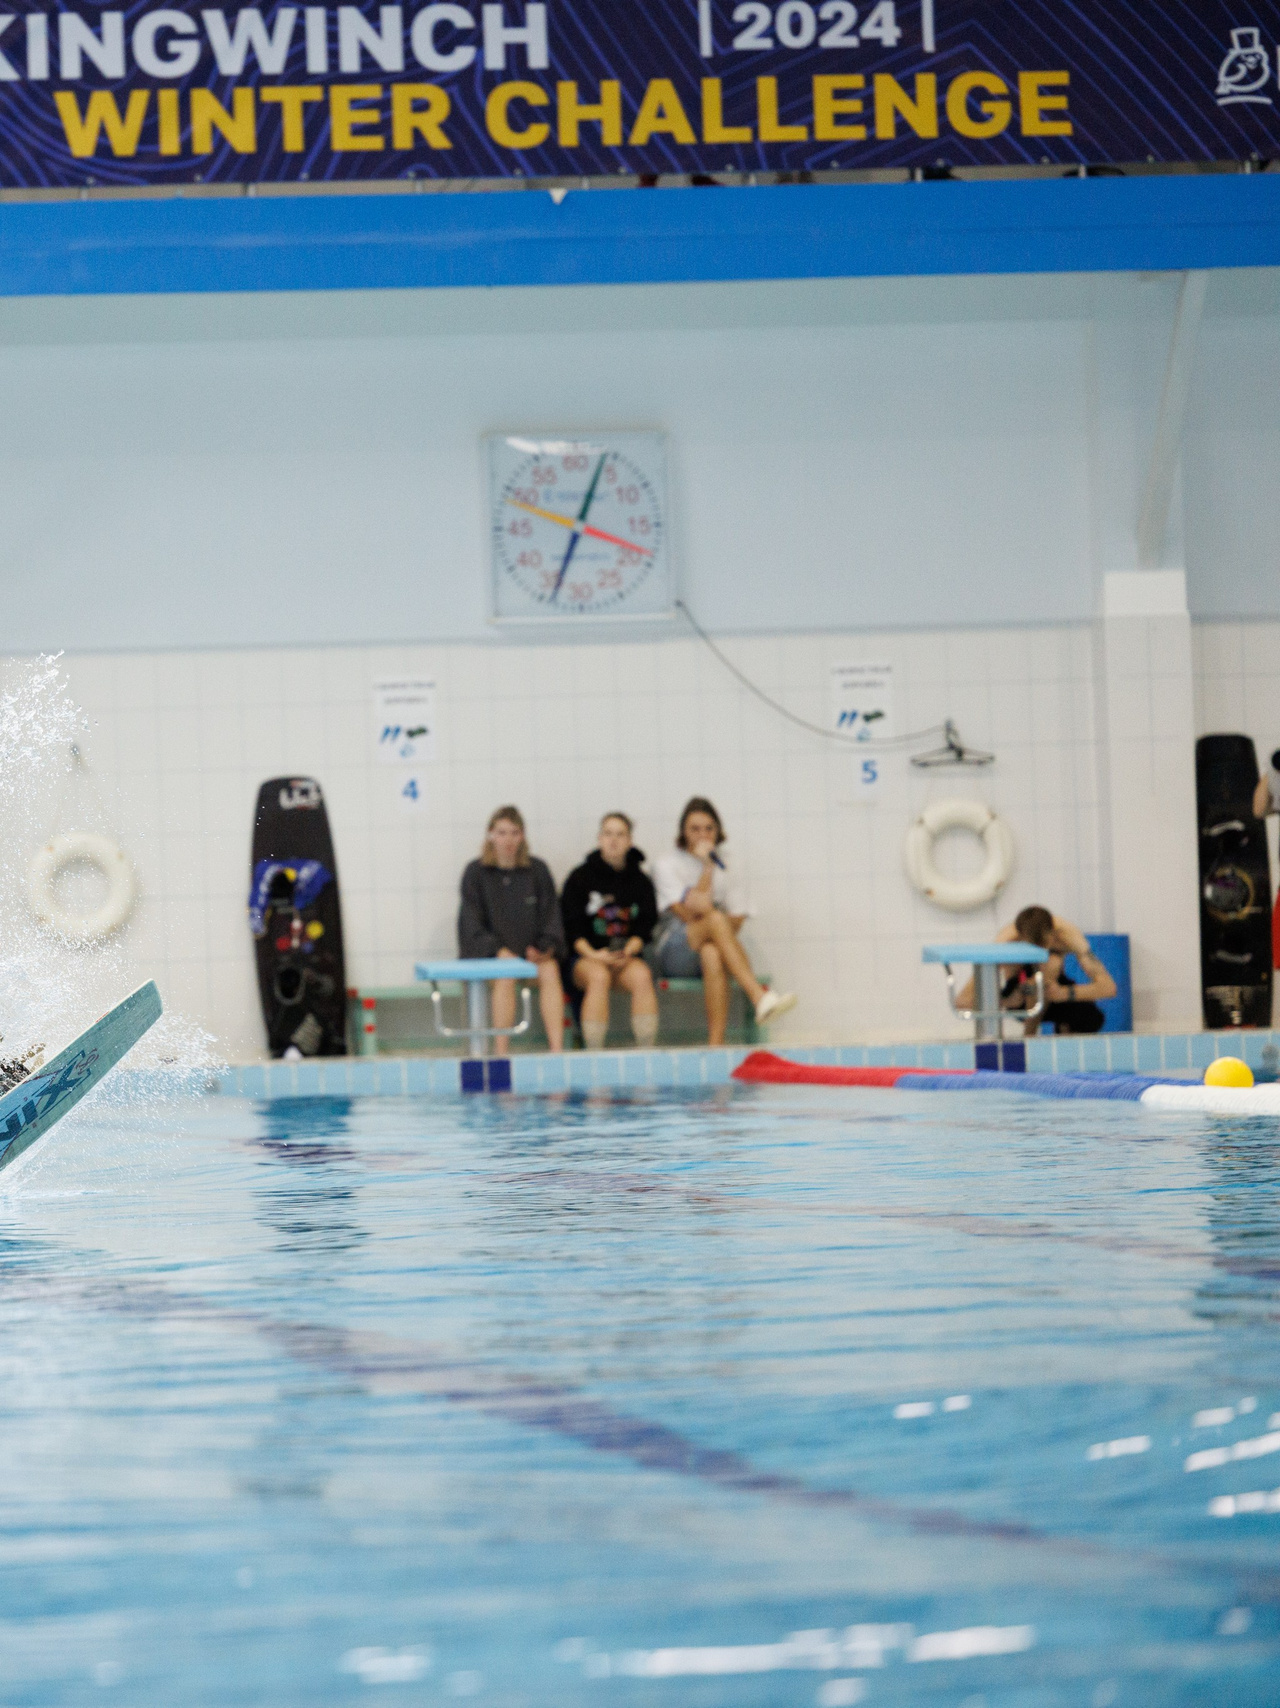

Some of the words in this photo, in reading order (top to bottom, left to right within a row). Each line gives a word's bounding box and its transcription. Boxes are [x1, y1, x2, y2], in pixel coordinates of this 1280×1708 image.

[732, 0, 902, 50] 2024
[52, 82, 453, 158] WINTER
[484, 70, 1074, 149] CHALLENGE
[562, 454, 589, 472] 60
[616, 484, 640, 505] 10
[508, 518, 533, 538] 45
[628, 515, 652, 535] 15
[516, 550, 543, 569] 40
[861, 759, 879, 784] 5
[401, 778, 419, 801] 4
